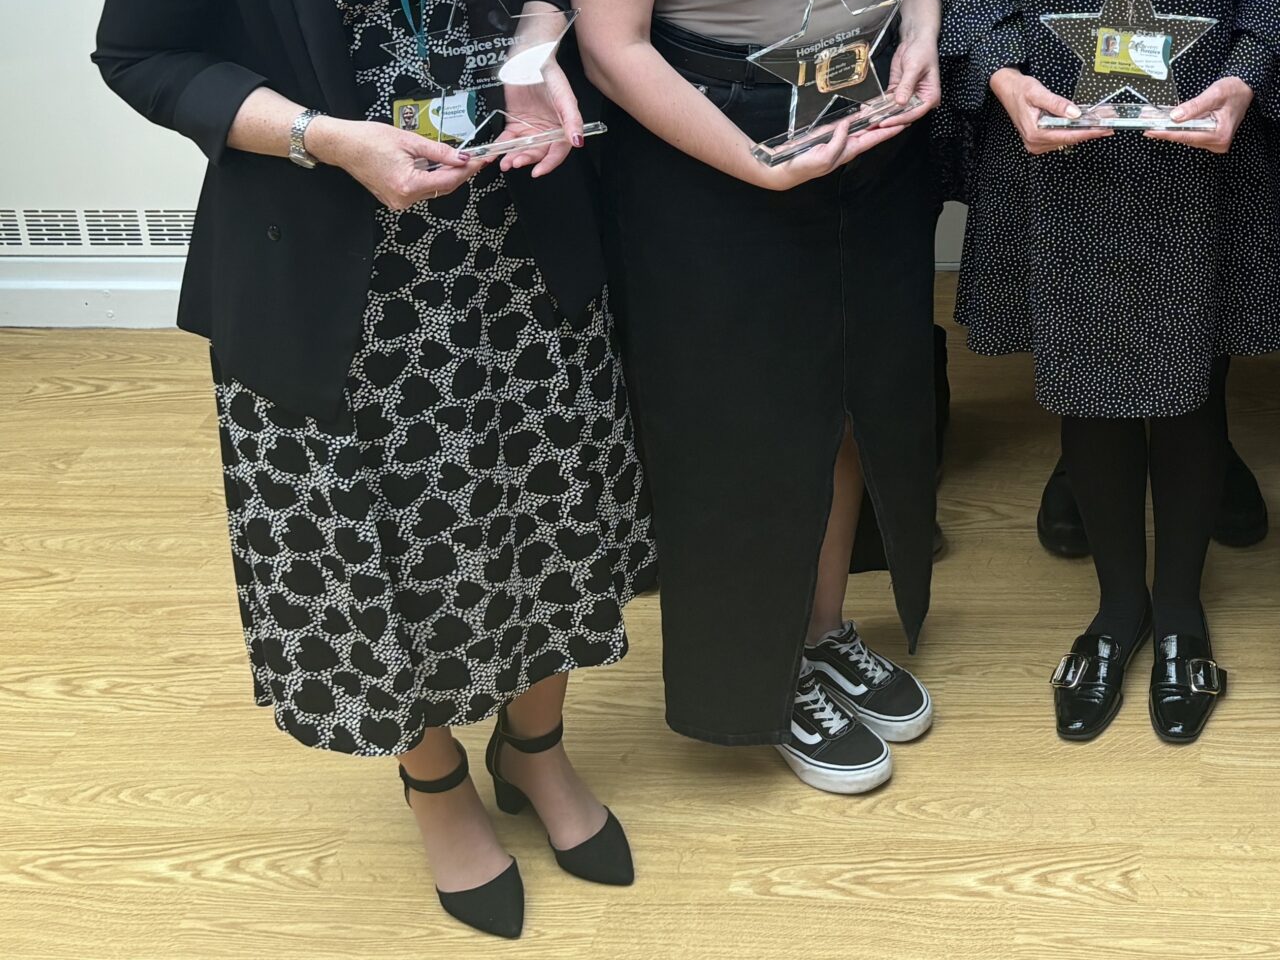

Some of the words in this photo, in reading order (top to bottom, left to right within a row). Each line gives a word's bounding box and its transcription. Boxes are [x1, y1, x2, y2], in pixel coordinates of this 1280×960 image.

[442, 40, 492, 58] Hospice
[796, 38, 834, 58] Hospice
[835, 28, 860, 42] Stars
